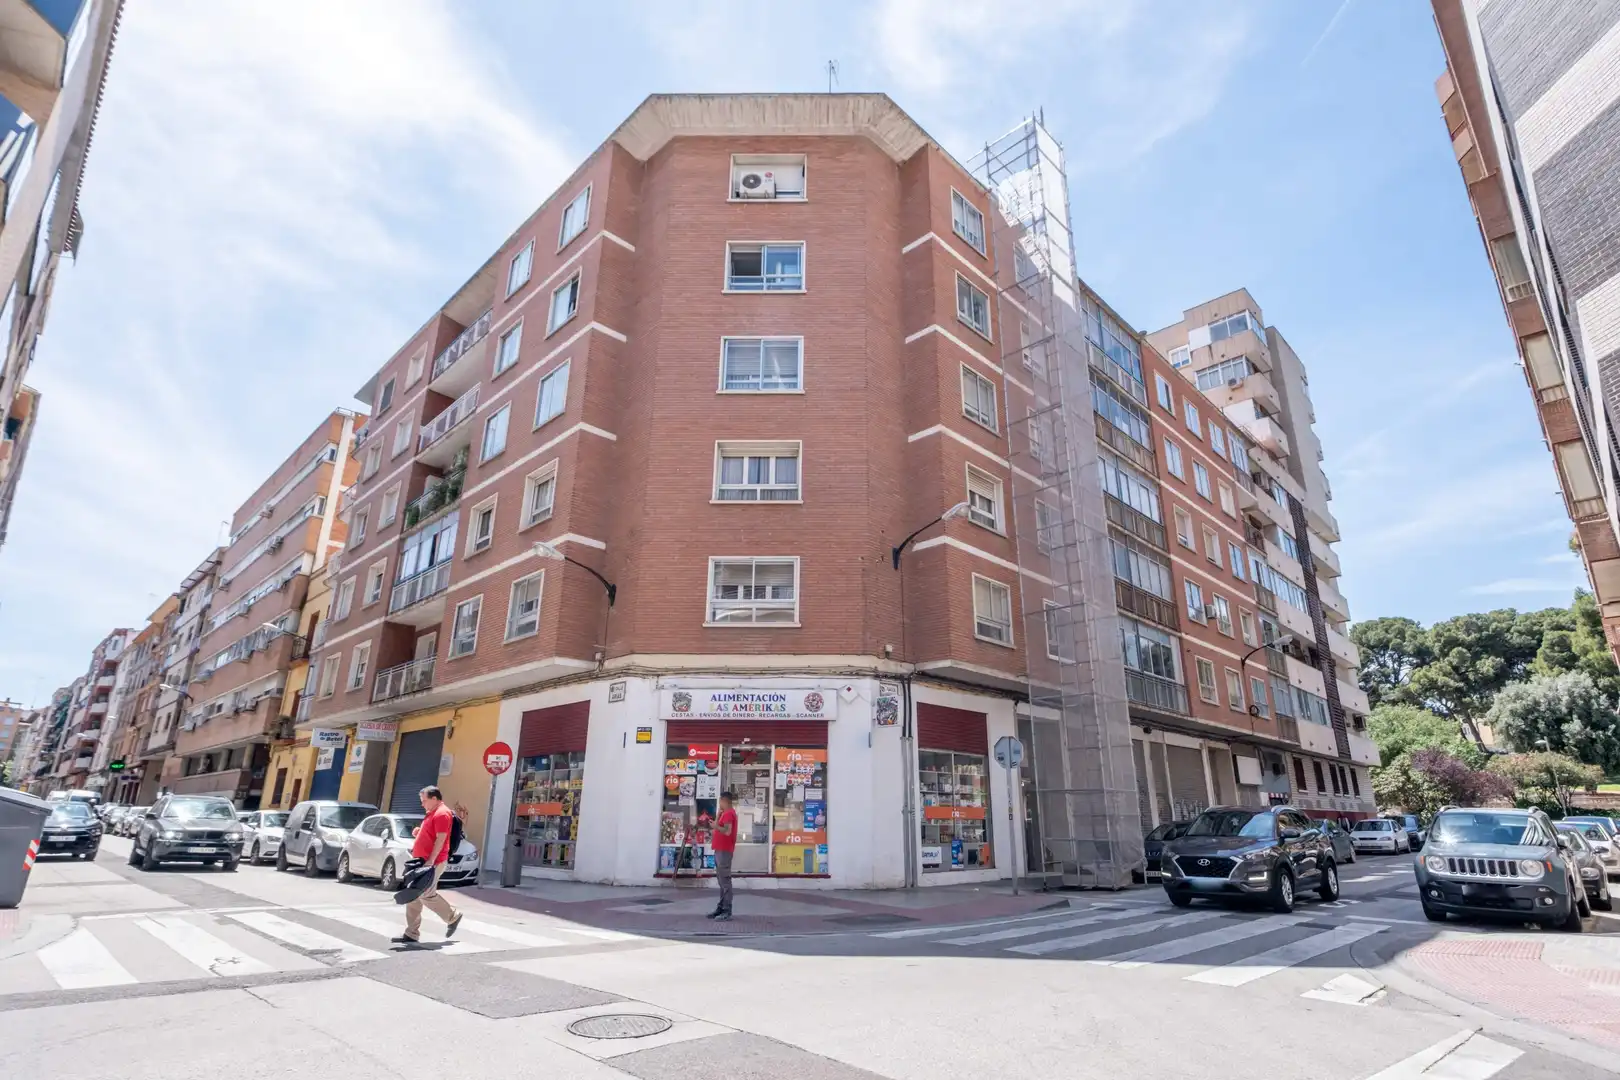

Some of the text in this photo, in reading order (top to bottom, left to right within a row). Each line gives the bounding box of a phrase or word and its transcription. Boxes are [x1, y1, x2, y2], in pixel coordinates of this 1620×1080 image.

[710, 692, 786, 702] ALIMENTACIÓN
[709, 702, 786, 712] LAS AMÉRIKAS
[787, 750, 802, 761] ria
[665, 775, 678, 784] ria
[785, 832, 802, 843] ria
